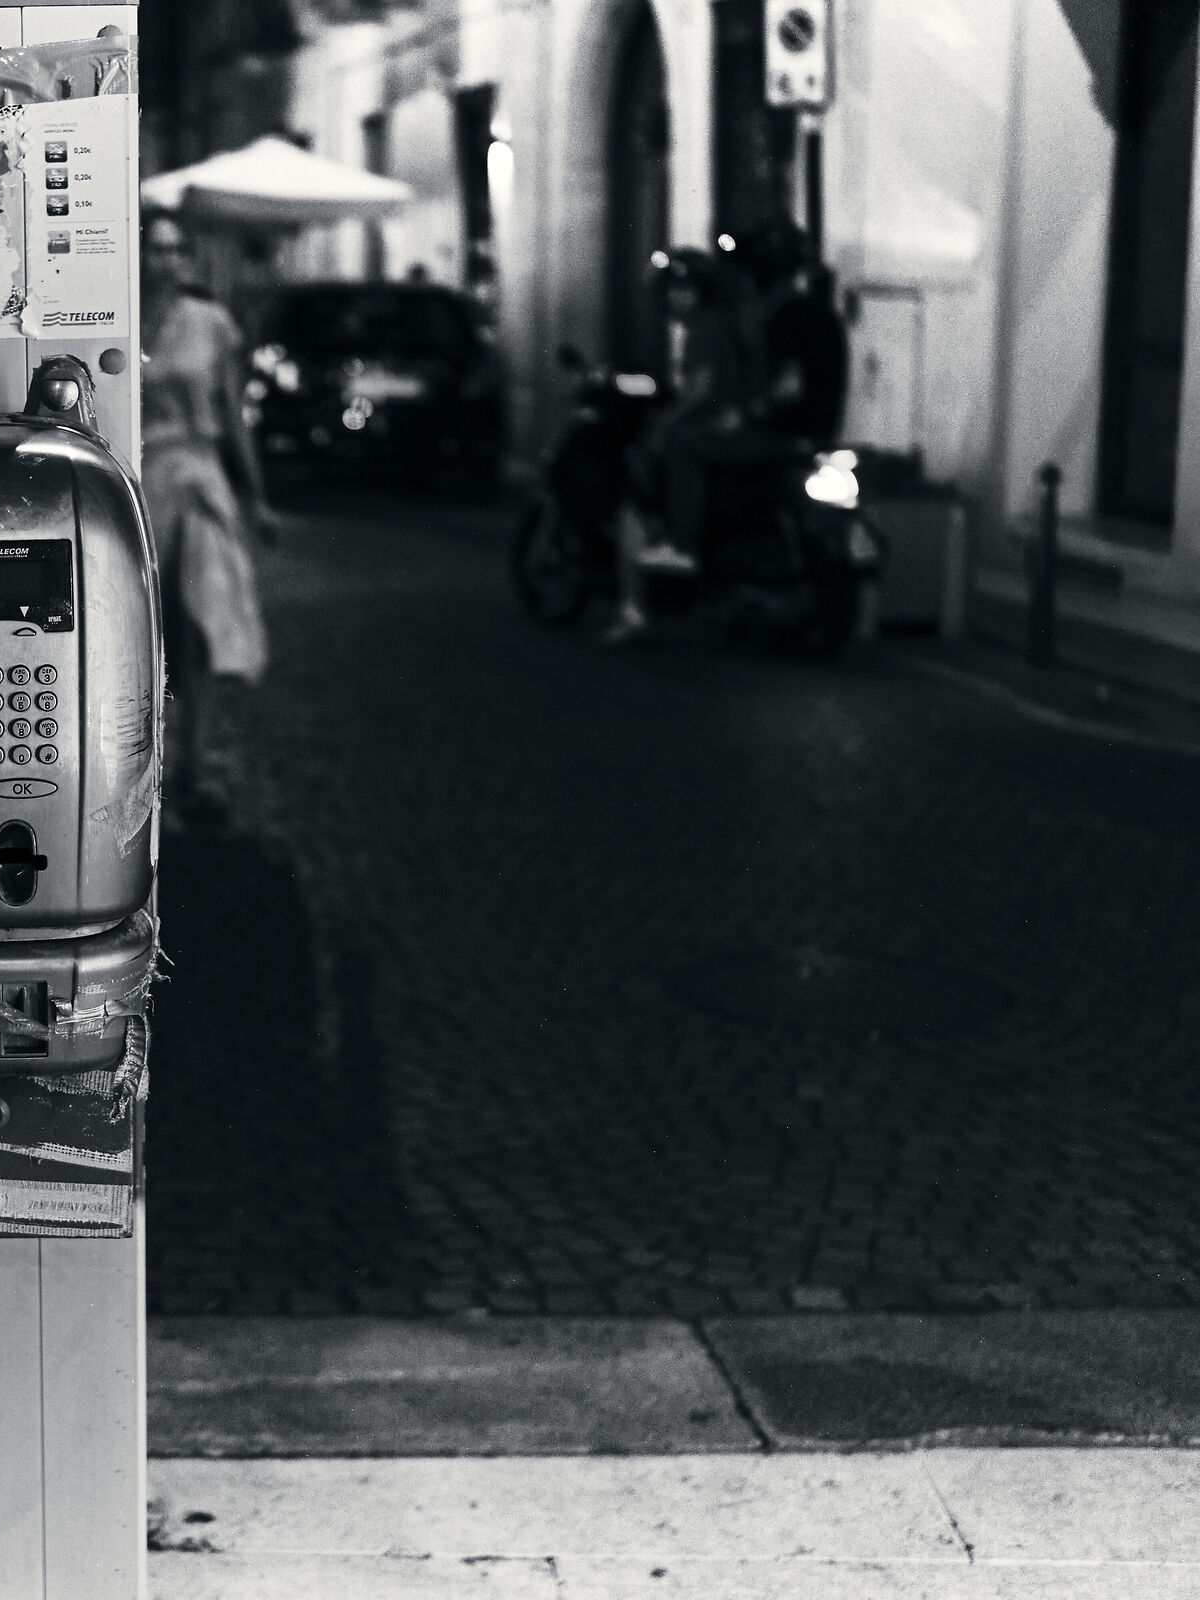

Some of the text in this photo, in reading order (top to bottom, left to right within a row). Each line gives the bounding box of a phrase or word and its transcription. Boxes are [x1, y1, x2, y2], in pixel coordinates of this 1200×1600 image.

[69, 312, 115, 321] TELECOM
[17, 674, 24, 683] 2
[44, 674, 51, 682] 3
[18, 702, 24, 710] 5
[44, 702, 51, 710] 6
[18, 754, 25, 762] 0
[12, 783, 32, 795] OK
